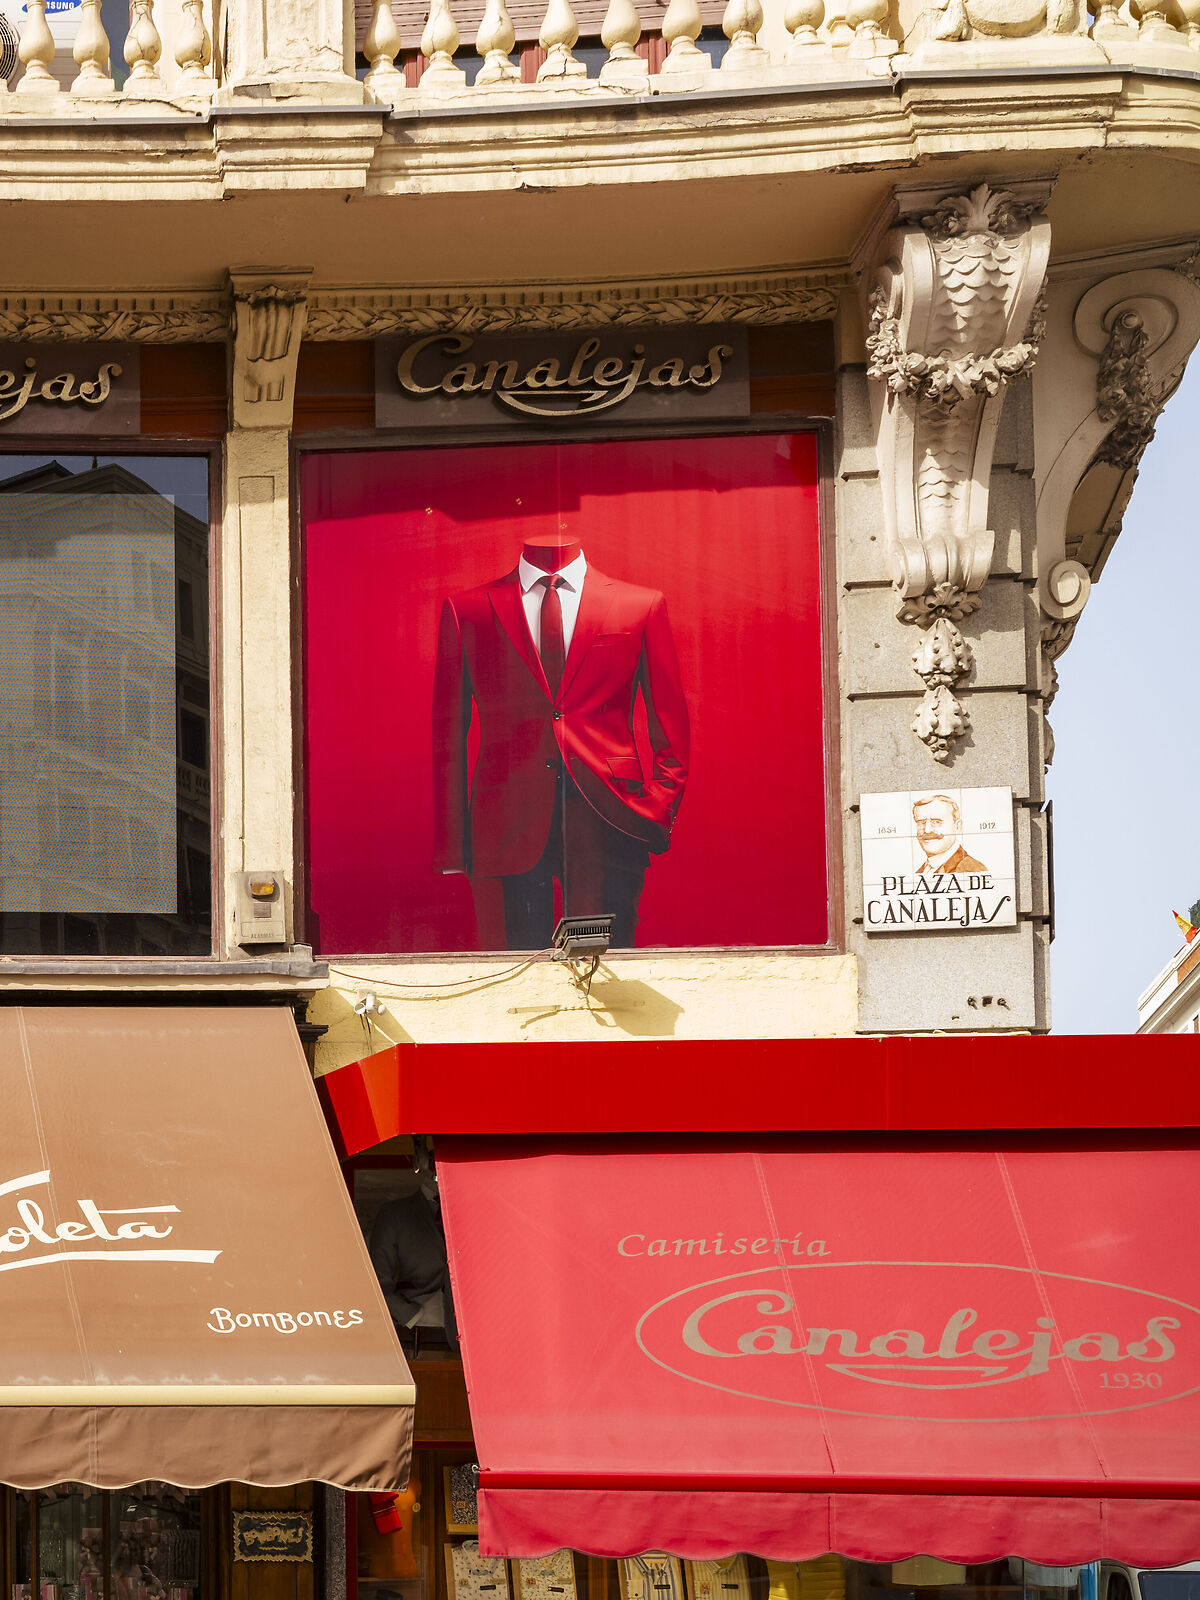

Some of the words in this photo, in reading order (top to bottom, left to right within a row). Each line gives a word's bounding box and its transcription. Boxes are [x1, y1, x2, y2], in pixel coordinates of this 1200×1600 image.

[398, 334, 733, 416] Canalejas
[878, 826, 897, 835] 1854
[979, 822, 996, 830] 1912
[880, 874, 966, 896] PLAZA
[968, 874, 995, 891] DE
[867, 895, 1011, 926] CANALEJAS
[617, 1232, 831, 1258] Camisería
[682, 1289, 1181, 1390] Canalejas
[1099, 1372, 1163, 1390] 1930
